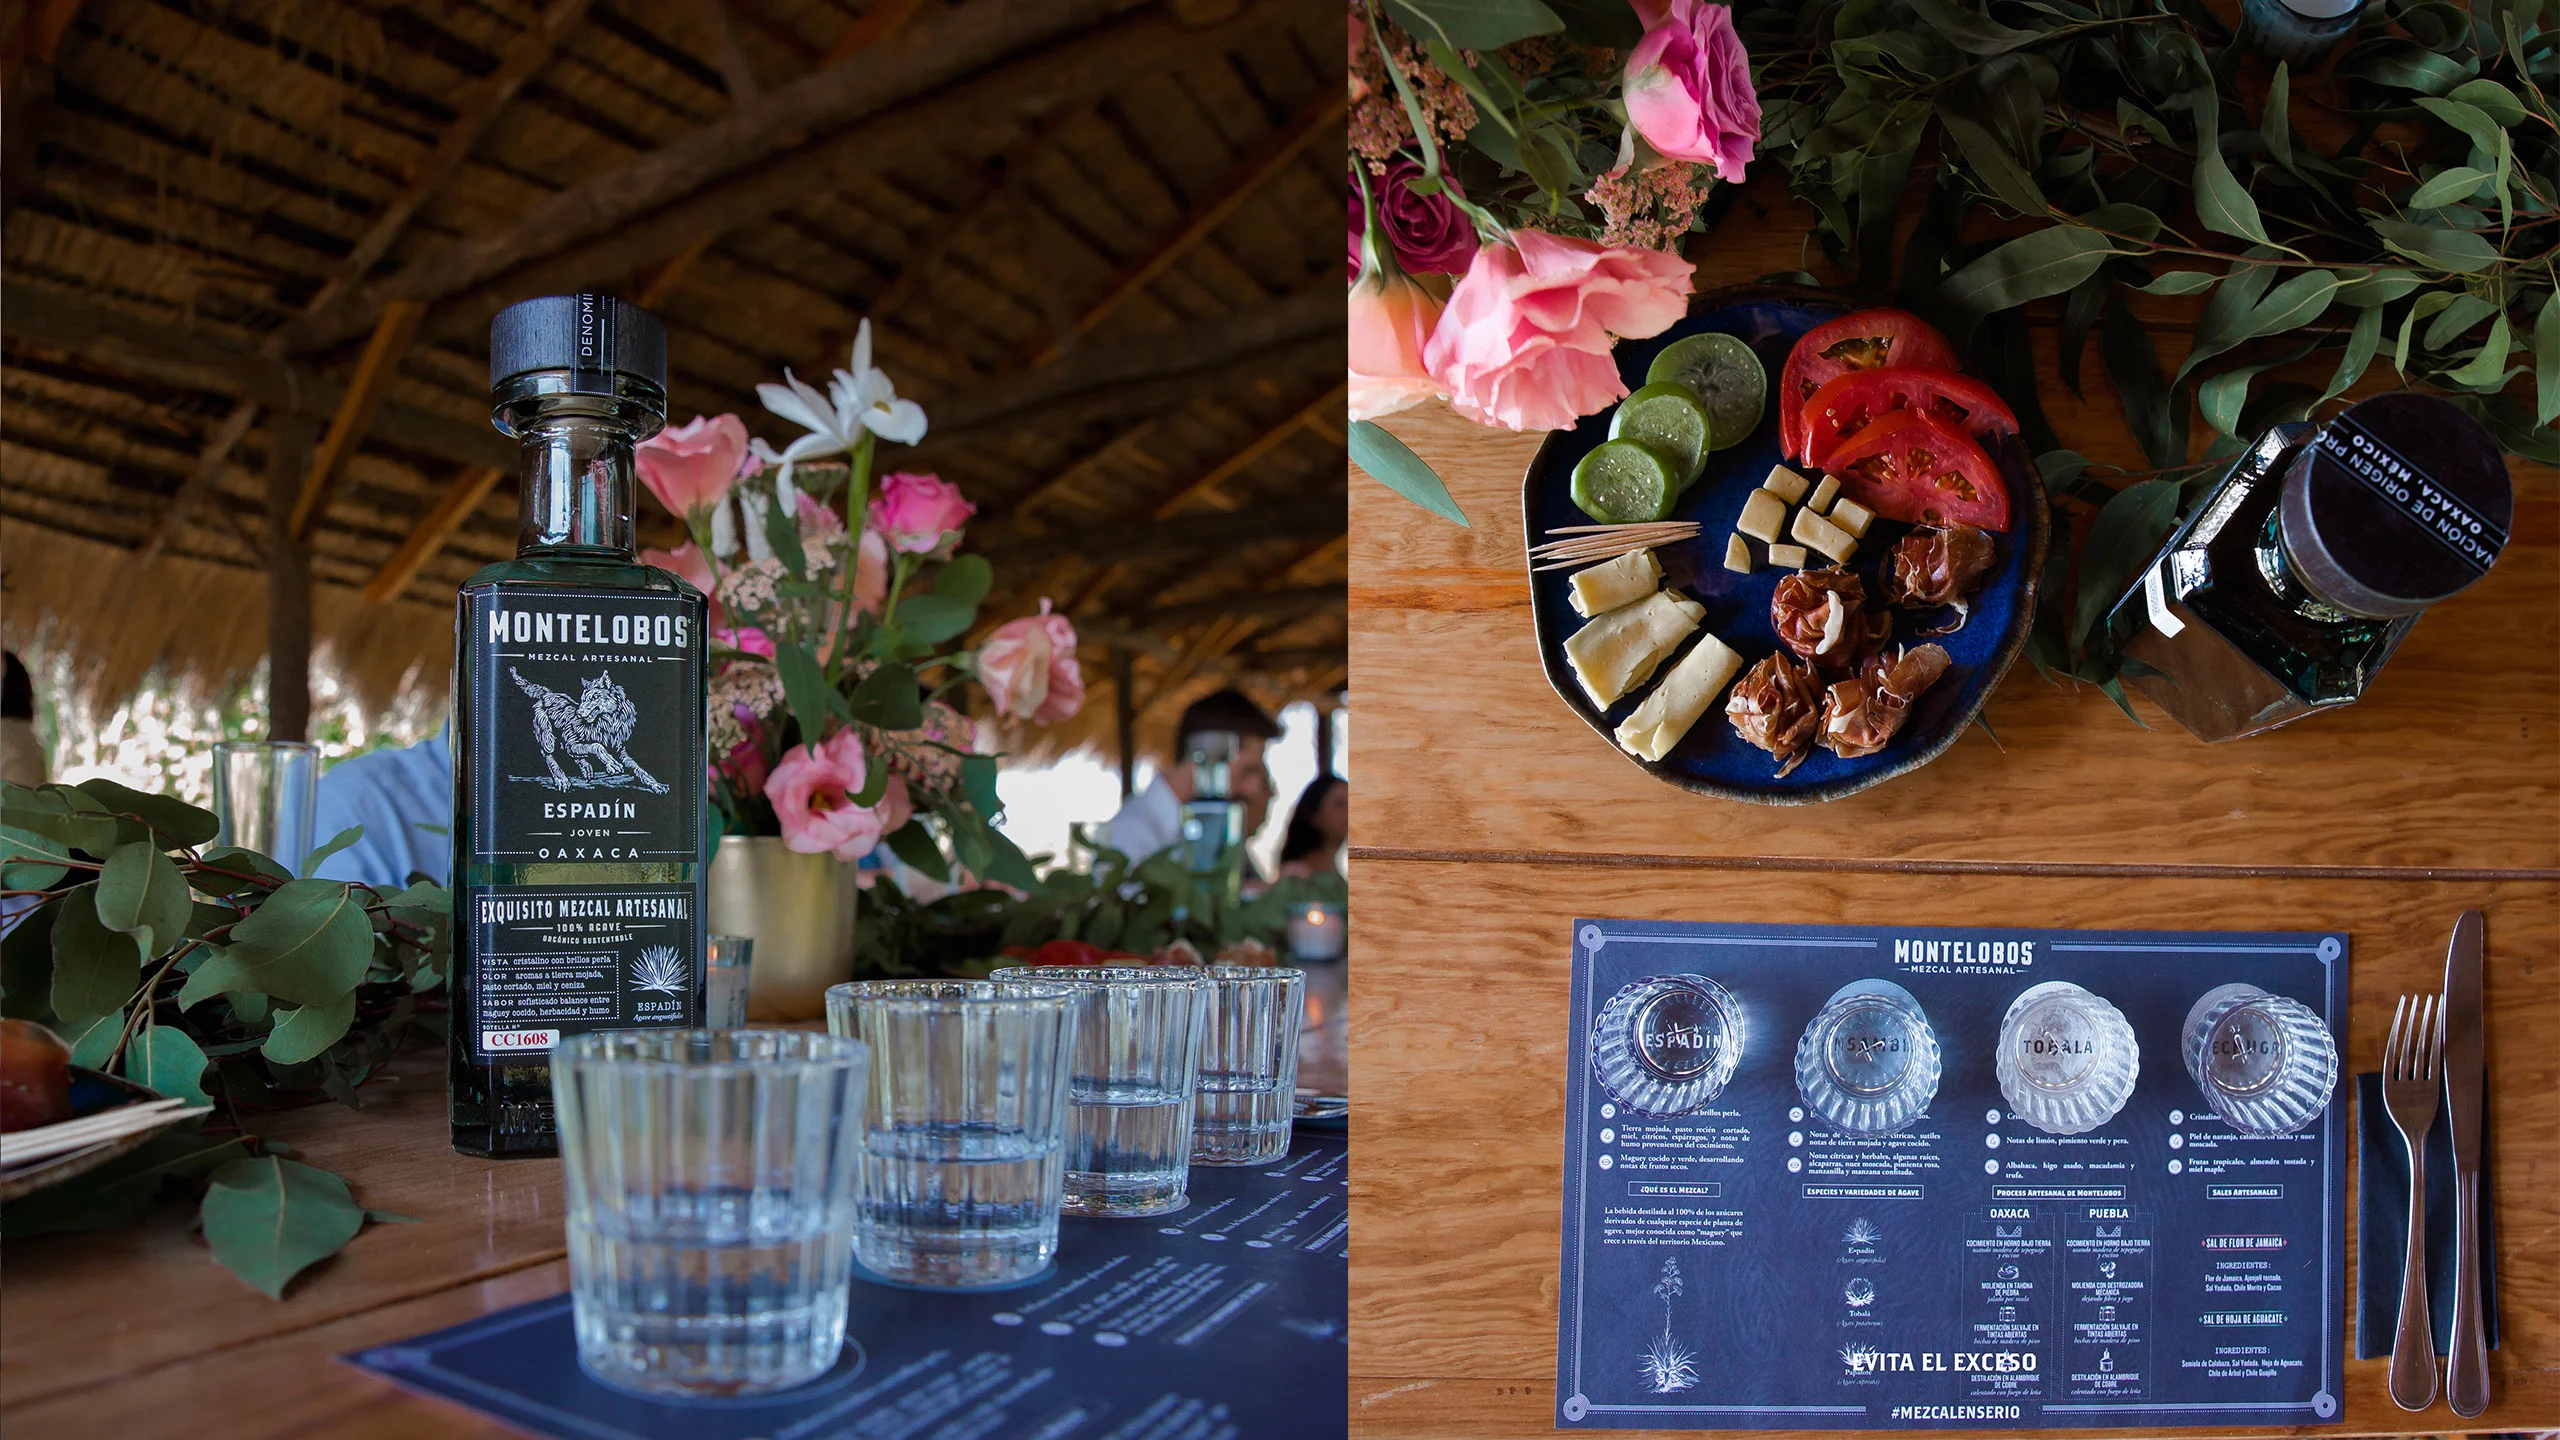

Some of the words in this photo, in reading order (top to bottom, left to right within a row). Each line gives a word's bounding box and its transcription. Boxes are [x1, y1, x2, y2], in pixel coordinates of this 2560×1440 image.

[2352, 434, 2412, 482] MÉXICO
[2349, 455, 2410, 502] ORIGEN
[2411, 500, 2435, 522] DE
[2418, 479, 2482, 534] OAXACA,
[489, 610, 688, 648] MONTELOBOS
[529, 653, 576, 662] MEZCAL
[582, 655, 653, 663] ARTESANAL
[544, 799, 635, 819] ESPADÍN
[570, 829, 610, 837] JOVEN
[539, 848, 639, 859] OAXACA
[482, 900, 552, 924] EXQUISITO
[559, 900, 611, 917] MEZCAL
[616, 898, 688, 920] ARTESANAL
[557, 923, 583, 932] 100%
[589, 922, 621, 932] AGAVE
[542, 934, 579, 945] ORGÁNICO
[582, 933, 633, 944] SUSTENTABLE
[1895, 939, 2032, 965] MONTELOBOS
[514, 957, 549, 965] cristalino
[566, 956, 590, 964] brillos
[592, 956, 611, 964] perla
[1911, 965, 1951, 973] MEZCAL
[1955, 966, 2015, 974] ARTESANAL
[515, 972, 543, 980] aromas
[552, 971, 573, 979] tierra
[576, 970, 604, 979] mojada,
[483, 983, 501, 991] pasto
[504, 982, 534, 990] cortado,
[536, 982, 552, 990] miel
[518, 998, 558, 1006] sofisticado
[637, 1000, 682, 1011] ESPADÍN
[483, 1010, 510, 1018] maguey
[540, 1008, 580, 1016] herbacidad
[492, 1033, 548, 1046] CC1608
[1646, 1031, 1721, 1048] ESPADÍN
[2036, 1137, 2057, 1145] limón,
[2059, 1137, 2088, 1145] pimiento
[2043, 1162, 2057, 1171] higo
[2214, 1158, 2245, 1166] tropicales,
[2204, 1166, 2225, 1174] maple.
[1990, 1209, 2030, 1218] OAXACA
[2089, 1209, 2128, 1218] PUEBLA
[1647, 1218, 1677, 1227] cualquier
[1679, 1218, 1702, 1227] especie
[1713, 1219, 1735, 1227] planta
[1626, 1228, 1645, 1236] mejor
[1731, 1230, 1743, 1238] que
[1648, 1237, 1658, 1245] del
[1691, 1238, 1725, 1246] Mexicano.
[2206, 1238, 2217, 1248] SAL
[2220, 1238, 2227, 1248] DE
[2229, 1238, 2244, 1248] FLOR
[2246, 1238, 2253, 1248] DE
[2255, 1237, 2282, 1248] JAMAICA
[2203, 1314, 2215, 1324] SAL
[2216, 1314, 2224, 1324] DE
[2225, 1314, 2242, 1324] HOJA
[2243, 1314, 2251, 1324] DE
[2253, 1314, 2282, 1324] AGUACATE
[2215, 1346, 2270, 1354] INGREDIENTES:
[1891, 1406, 2020, 1419] #MEZCALENSERIO
